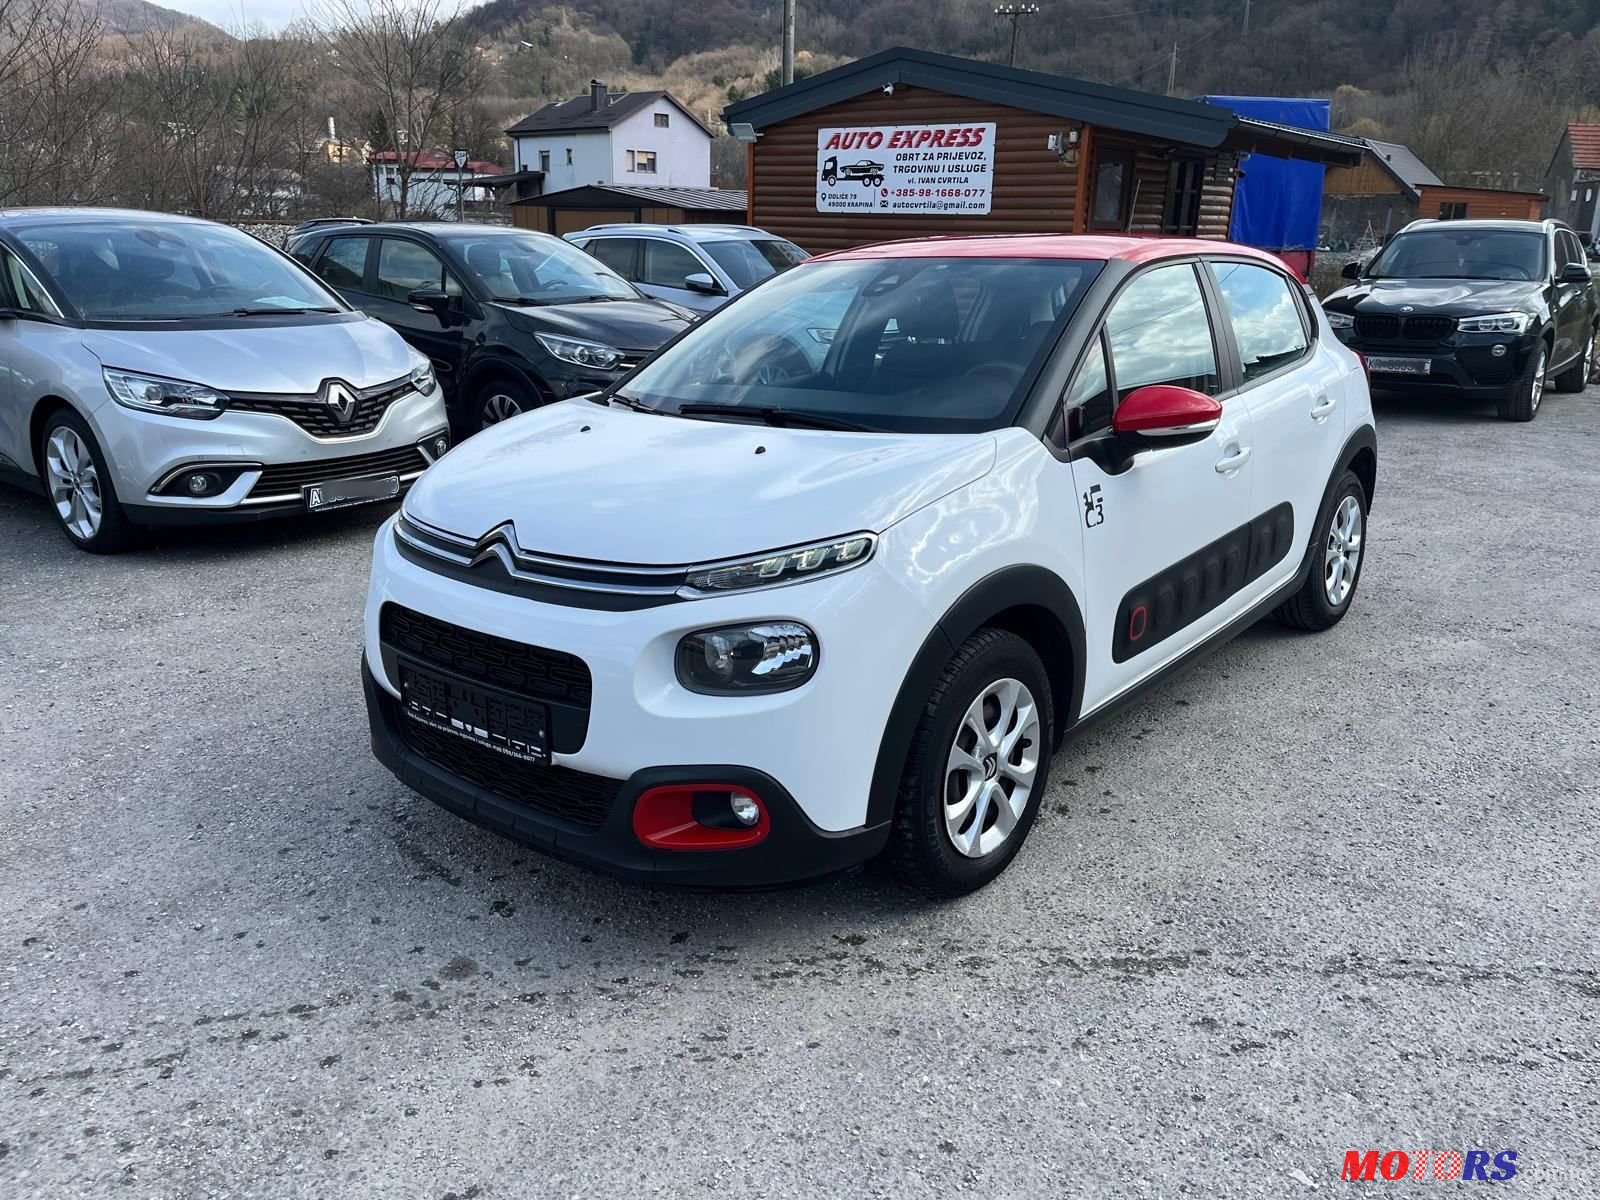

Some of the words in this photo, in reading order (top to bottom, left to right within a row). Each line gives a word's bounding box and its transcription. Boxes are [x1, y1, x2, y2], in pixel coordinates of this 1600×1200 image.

[825, 131, 884, 150] AUTO
[887, 127, 986, 149] EXPRESS
[895, 153, 920, 161] OBRT
[922, 152, 935, 161] ZA
[936, 151, 987, 161] PRIJEVOZ,
[893, 164, 941, 174] TRGOVINU
[942, 164, 946, 173] I
[947, 163, 987, 173] USLUGE
[937, 176, 969, 184] CVRTILA
[890, 188, 986, 198] +385-98-1668-077
[892, 200, 986, 211] autocvrtila@gmail.com
